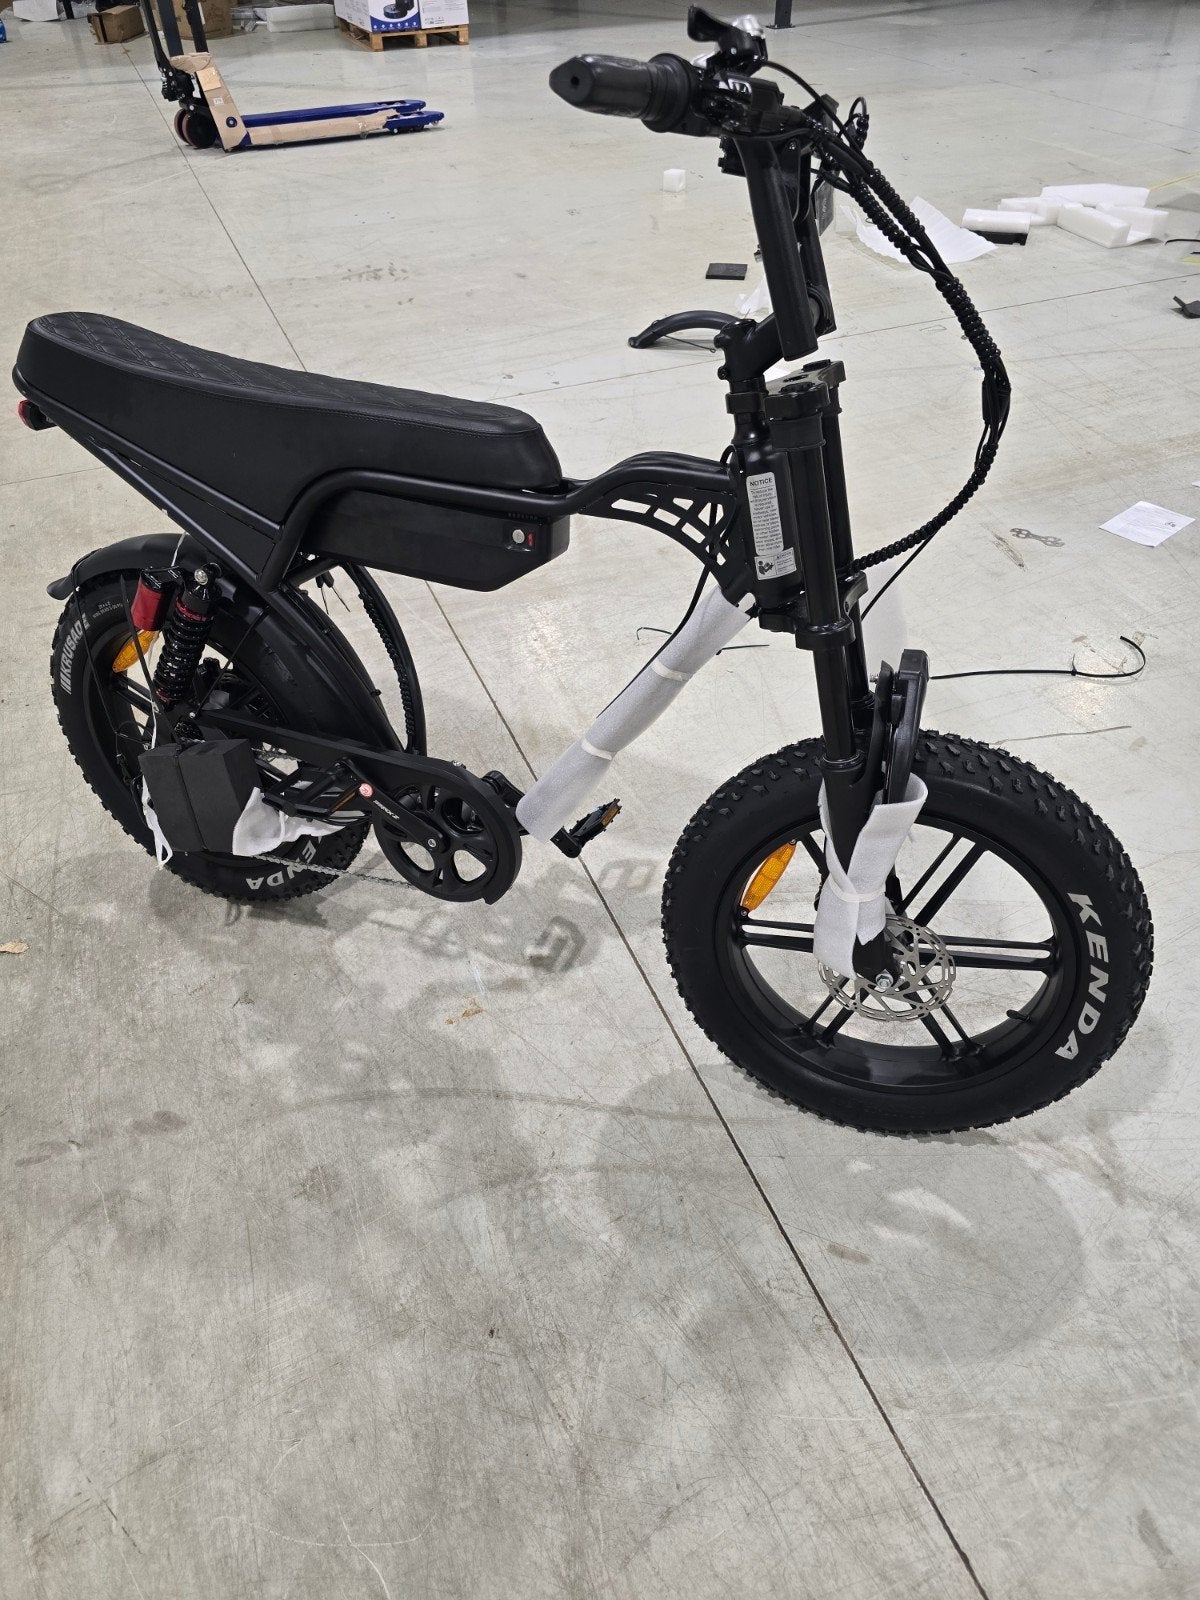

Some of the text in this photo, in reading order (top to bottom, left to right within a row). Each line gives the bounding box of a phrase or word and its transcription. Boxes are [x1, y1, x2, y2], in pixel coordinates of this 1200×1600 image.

[749, 477, 773, 487] NOTICE
[245, 836, 322, 890] ENDA
[1054, 892, 1109, 1060] KENDA
